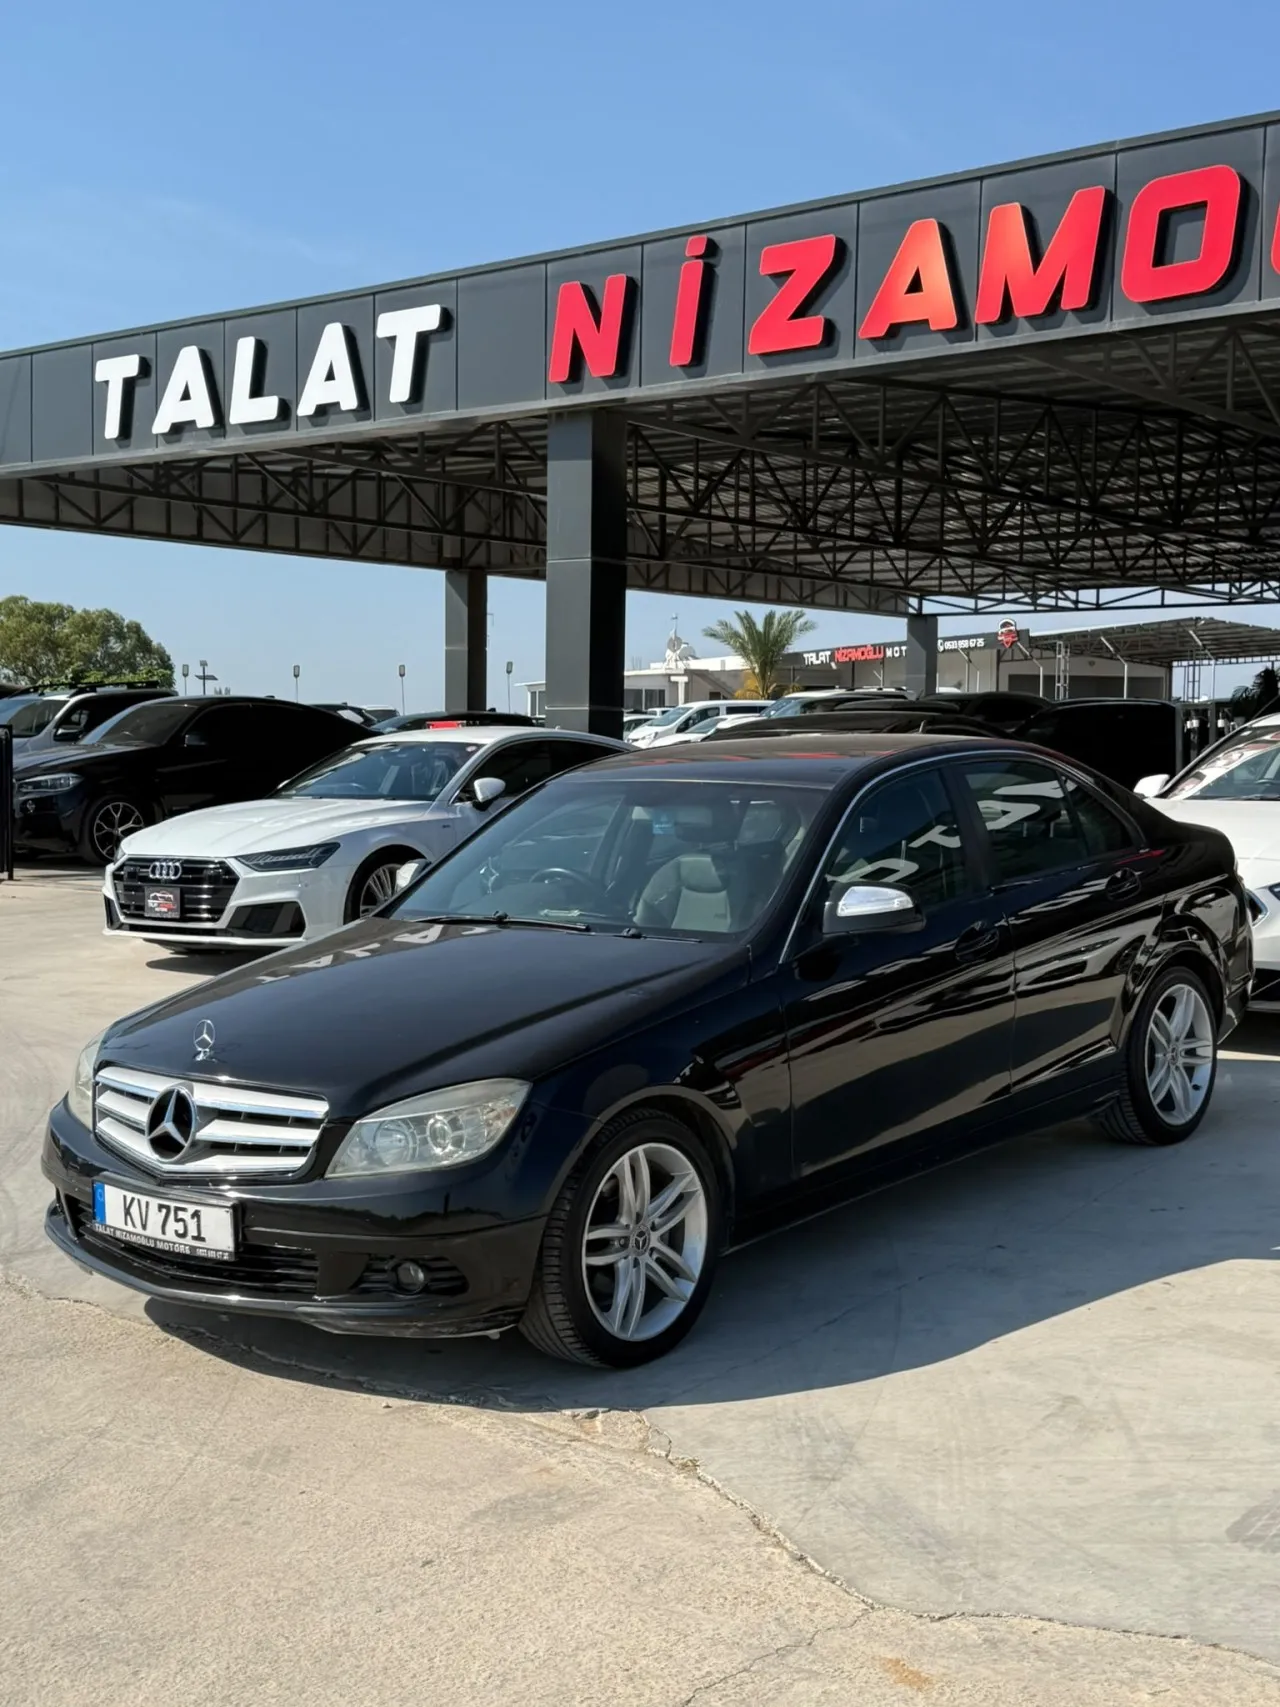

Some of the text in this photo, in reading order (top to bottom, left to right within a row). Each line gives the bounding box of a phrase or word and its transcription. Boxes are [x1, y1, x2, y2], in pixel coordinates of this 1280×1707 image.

[95, 165, 1280, 440] TALAT NİZAMO
[803, 650, 832, 665] TALAT
[122, 1194, 207, 1243] KV 751
[156, 1240, 191, 1254] MOTORS
